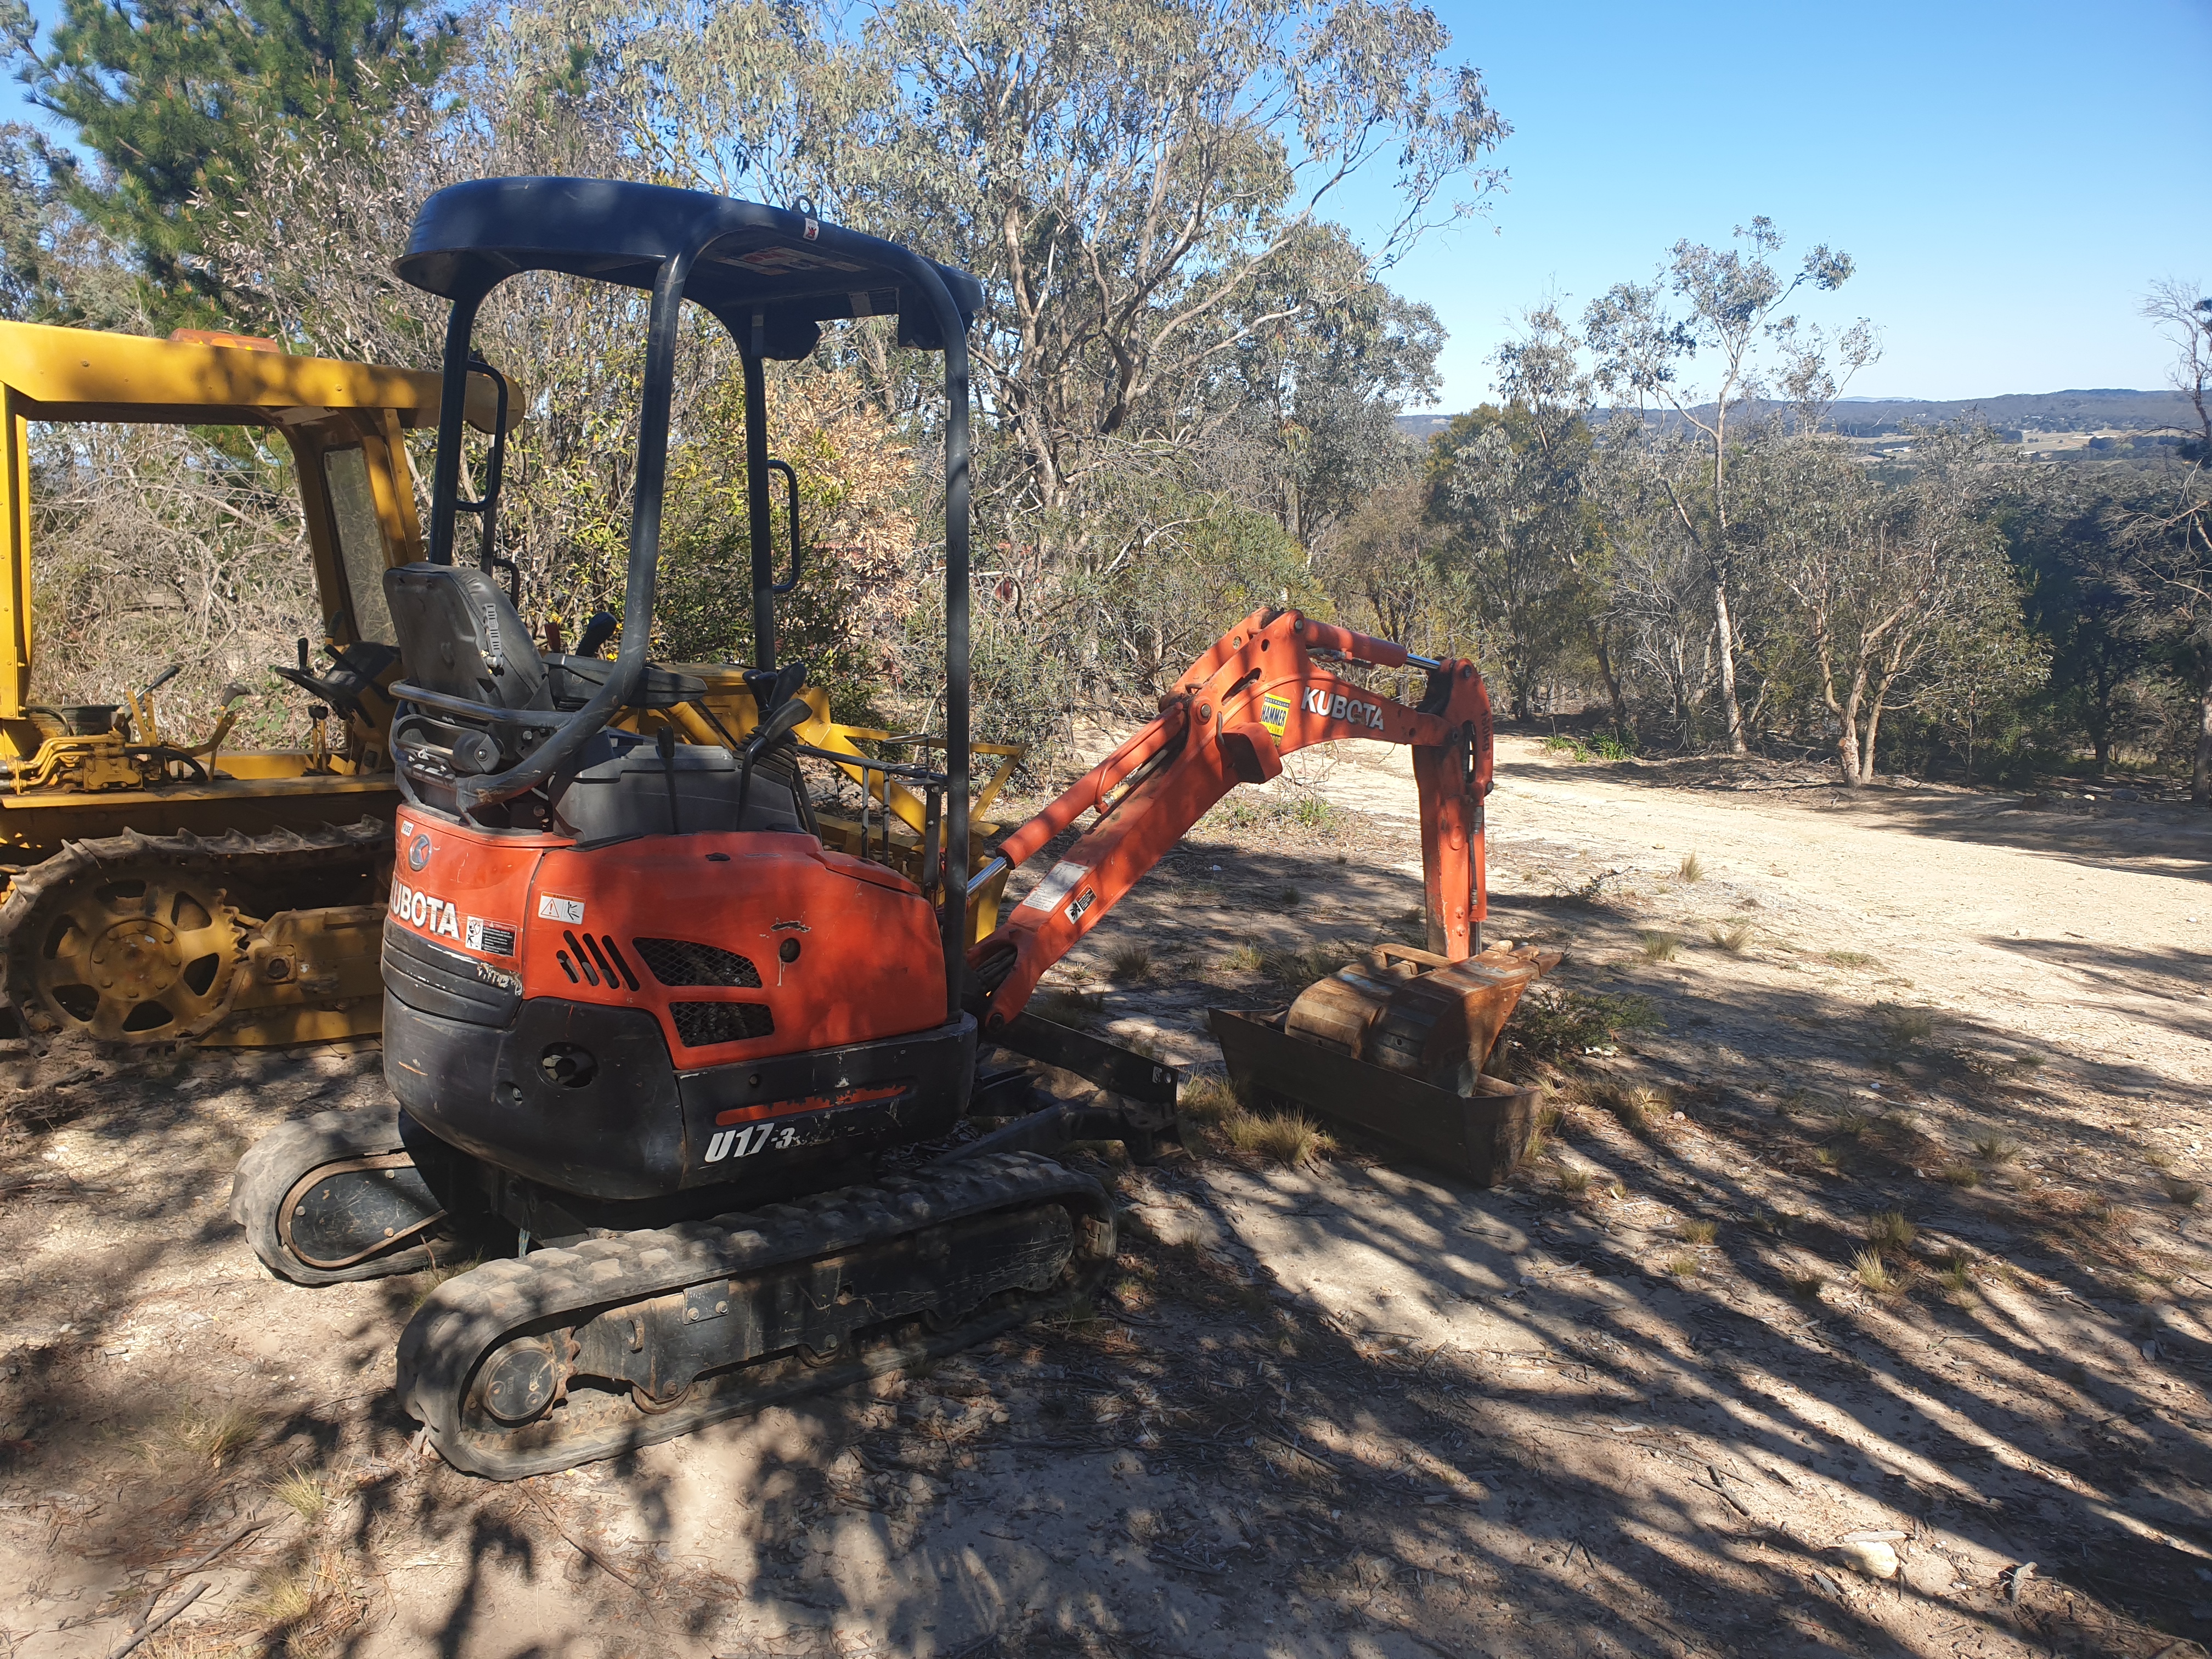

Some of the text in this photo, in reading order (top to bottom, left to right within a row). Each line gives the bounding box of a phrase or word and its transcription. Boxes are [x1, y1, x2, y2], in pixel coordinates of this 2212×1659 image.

[1265, 697, 1289, 707] AUSTRALIAN
[1301, 687, 1383, 730] KUBOTA
[1262, 705, 1286, 727] HAMMER
[403, 823, 411, 833] FUSE
